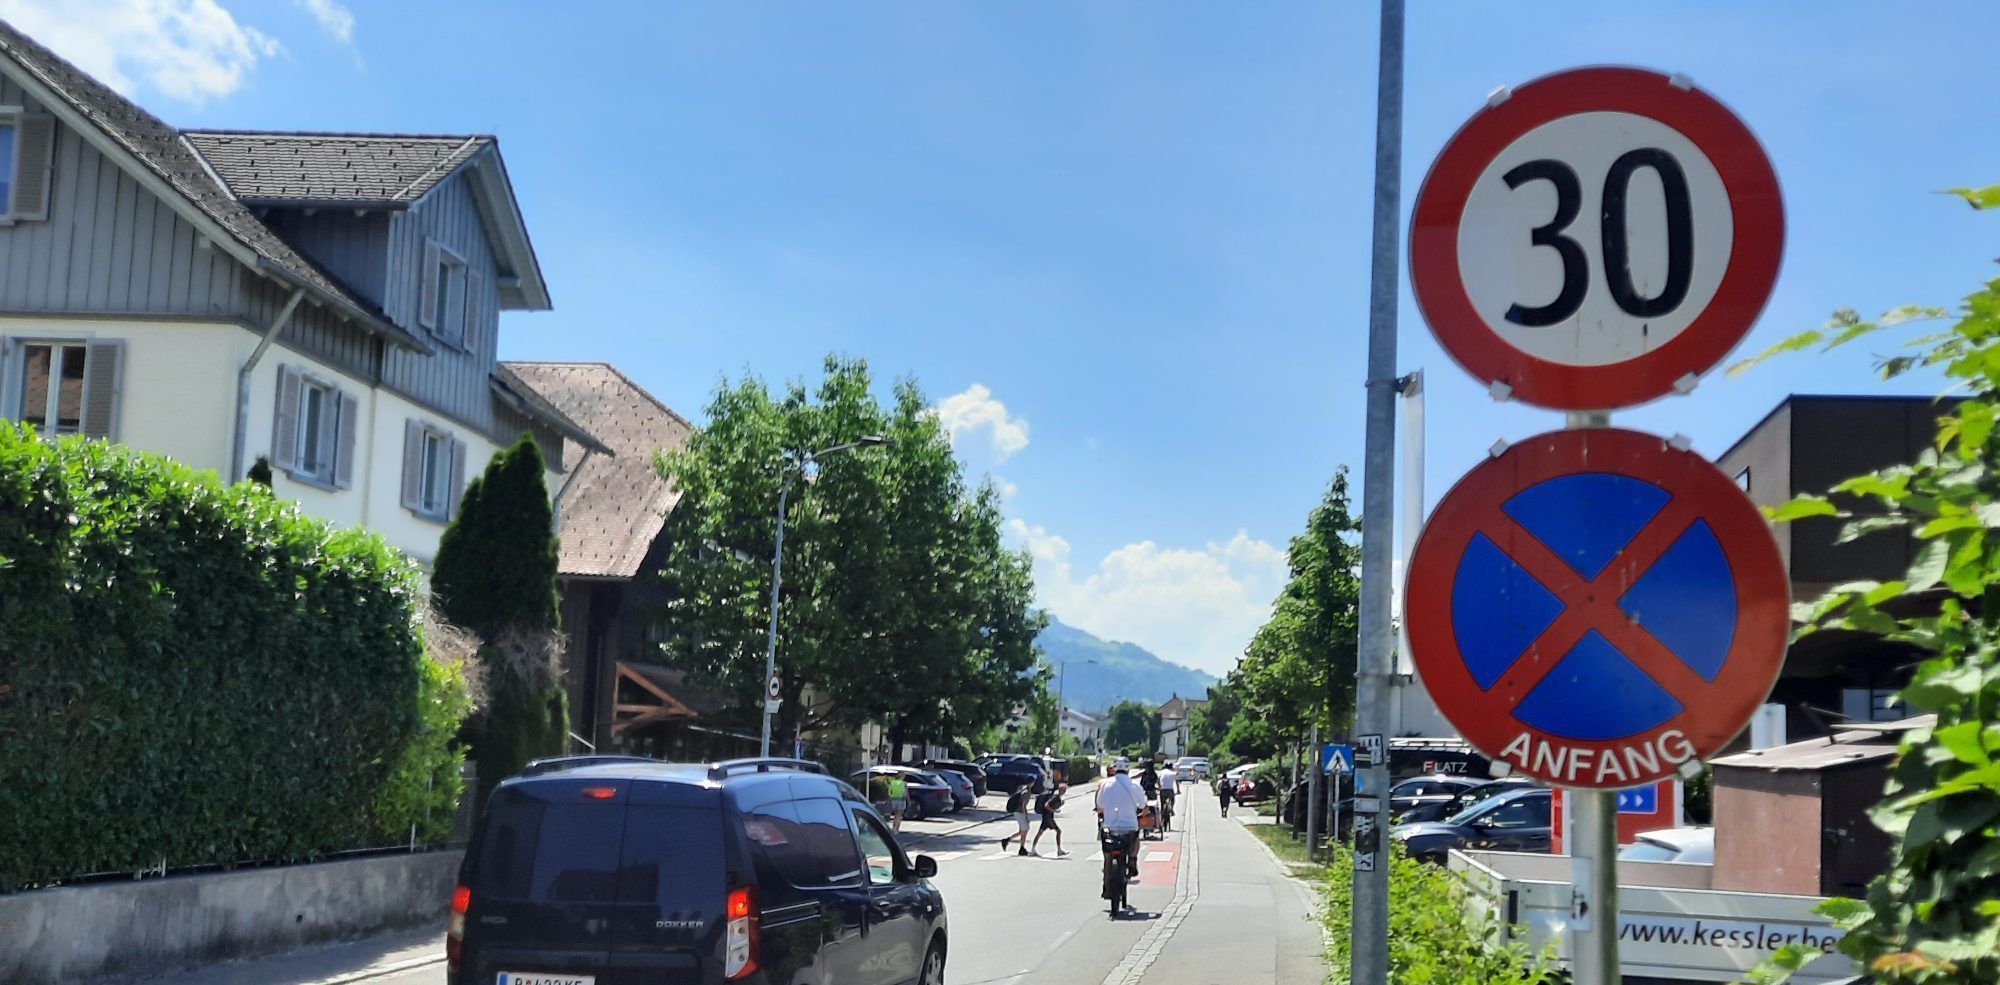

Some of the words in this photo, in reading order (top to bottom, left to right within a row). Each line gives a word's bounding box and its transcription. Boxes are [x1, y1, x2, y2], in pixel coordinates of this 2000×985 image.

[1502, 147, 1694, 327] 30
[1423, 760, 1468, 773] FLATZ
[1500, 729, 1697, 783] ANFANG
[656, 920, 704, 929] DOKKER
